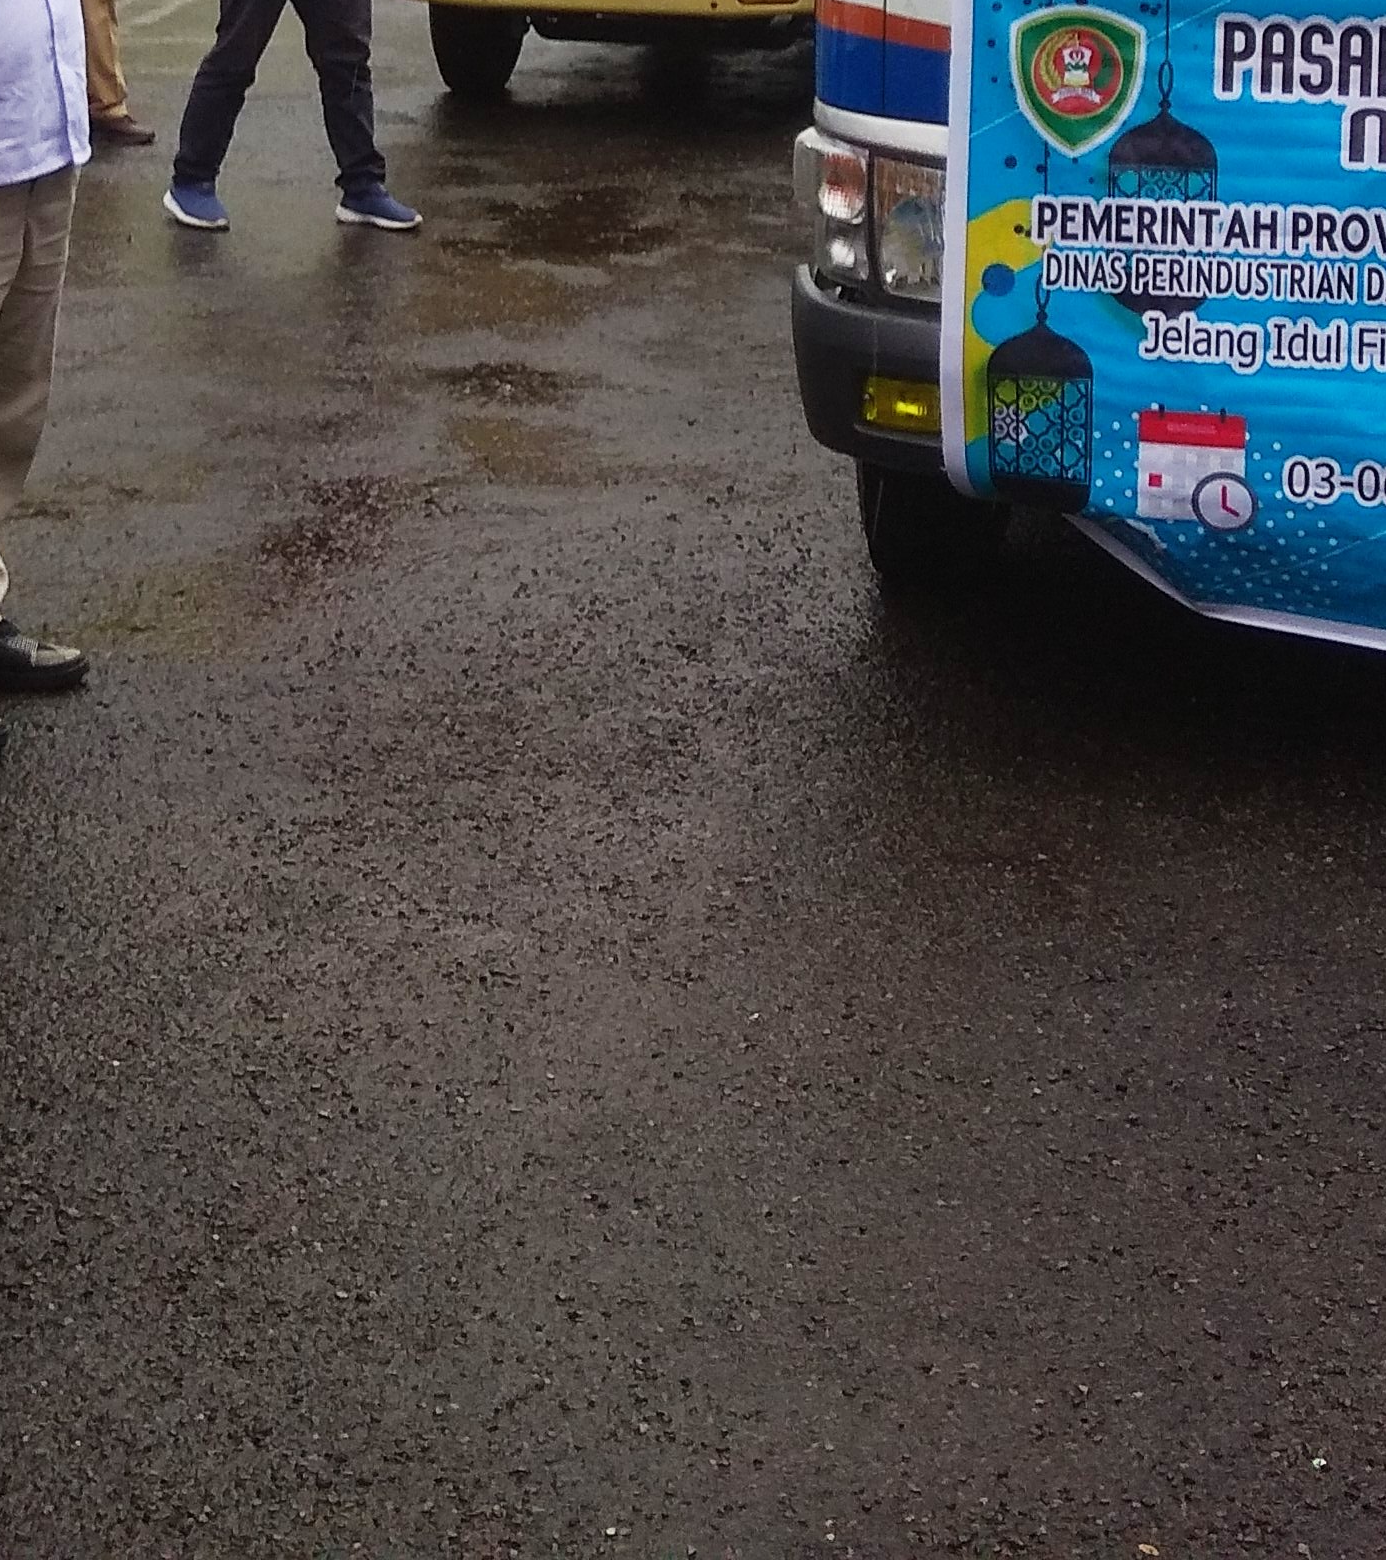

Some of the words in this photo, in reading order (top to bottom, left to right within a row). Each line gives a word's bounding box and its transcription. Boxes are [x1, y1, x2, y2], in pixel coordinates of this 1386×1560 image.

[1036, 201, 1279, 251] PEMERINTAH
[1045, 252, 1123, 290] DINAS
[1133, 257, 1354, 301] PERINDUSTRIAN
[1143, 317, 1258, 368] Jelang
[1272, 322, 1342, 364] Idul
